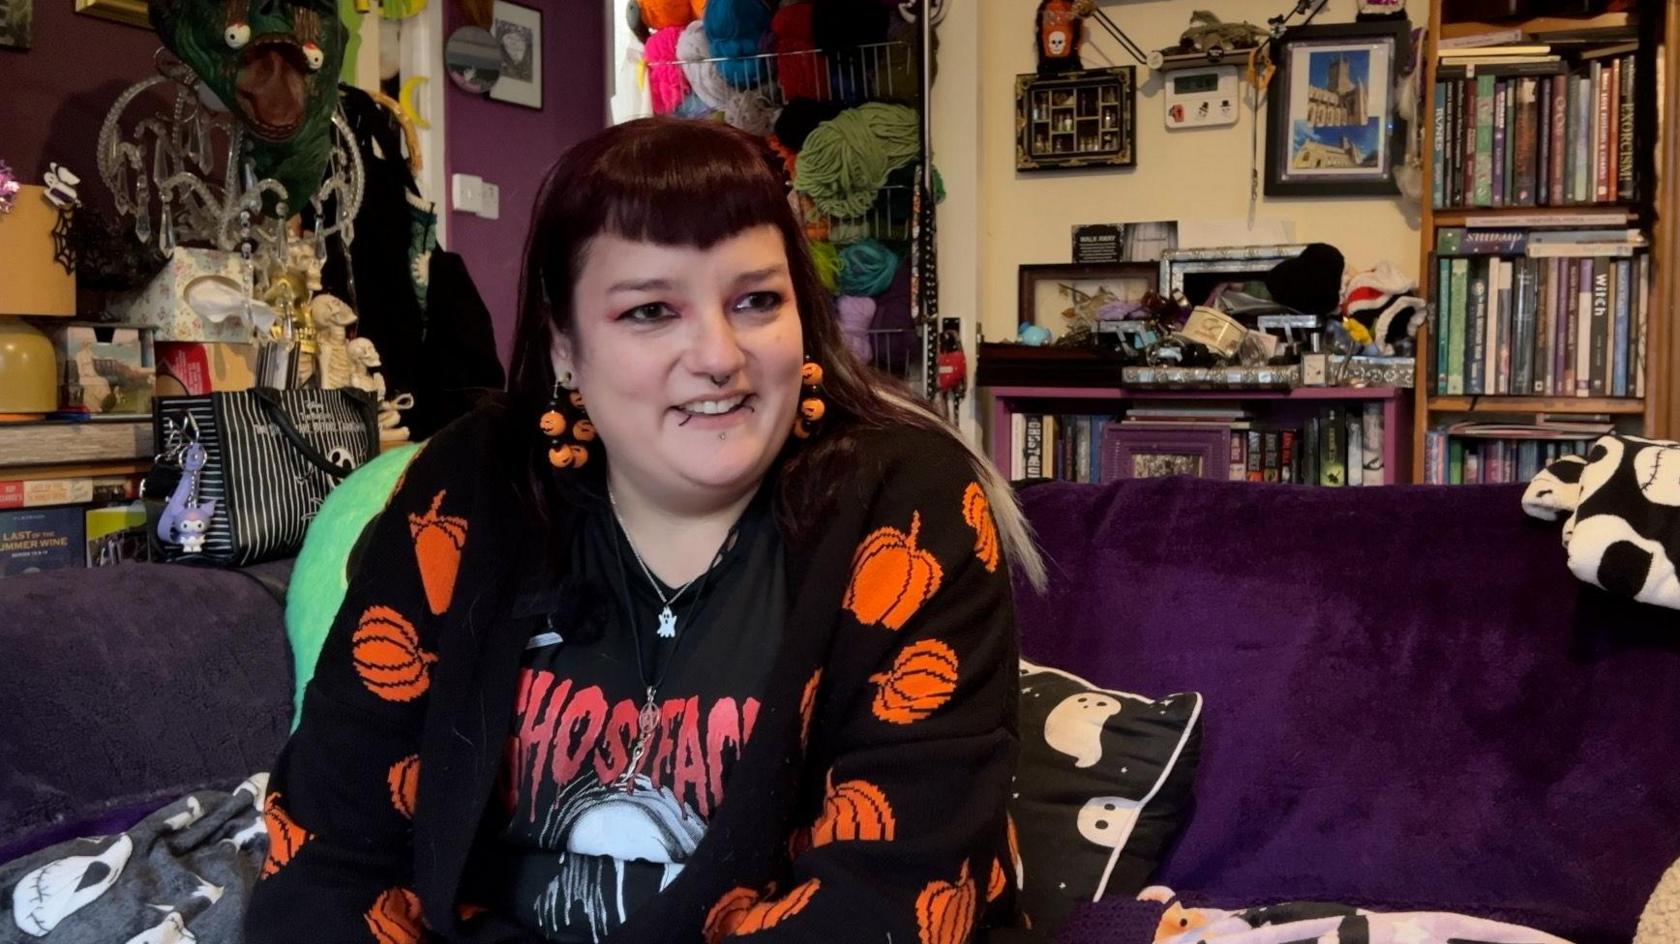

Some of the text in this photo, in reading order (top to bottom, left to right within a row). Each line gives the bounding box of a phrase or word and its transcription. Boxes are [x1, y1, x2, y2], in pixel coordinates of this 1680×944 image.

[1619, 103, 1634, 182] EXORCISM!
[1467, 232, 1522, 250] dreams
[1027, 421, 1041, 455] GHOST
[3, 531, 32, 541] LAST
[40, 537, 67, 547] WINE
